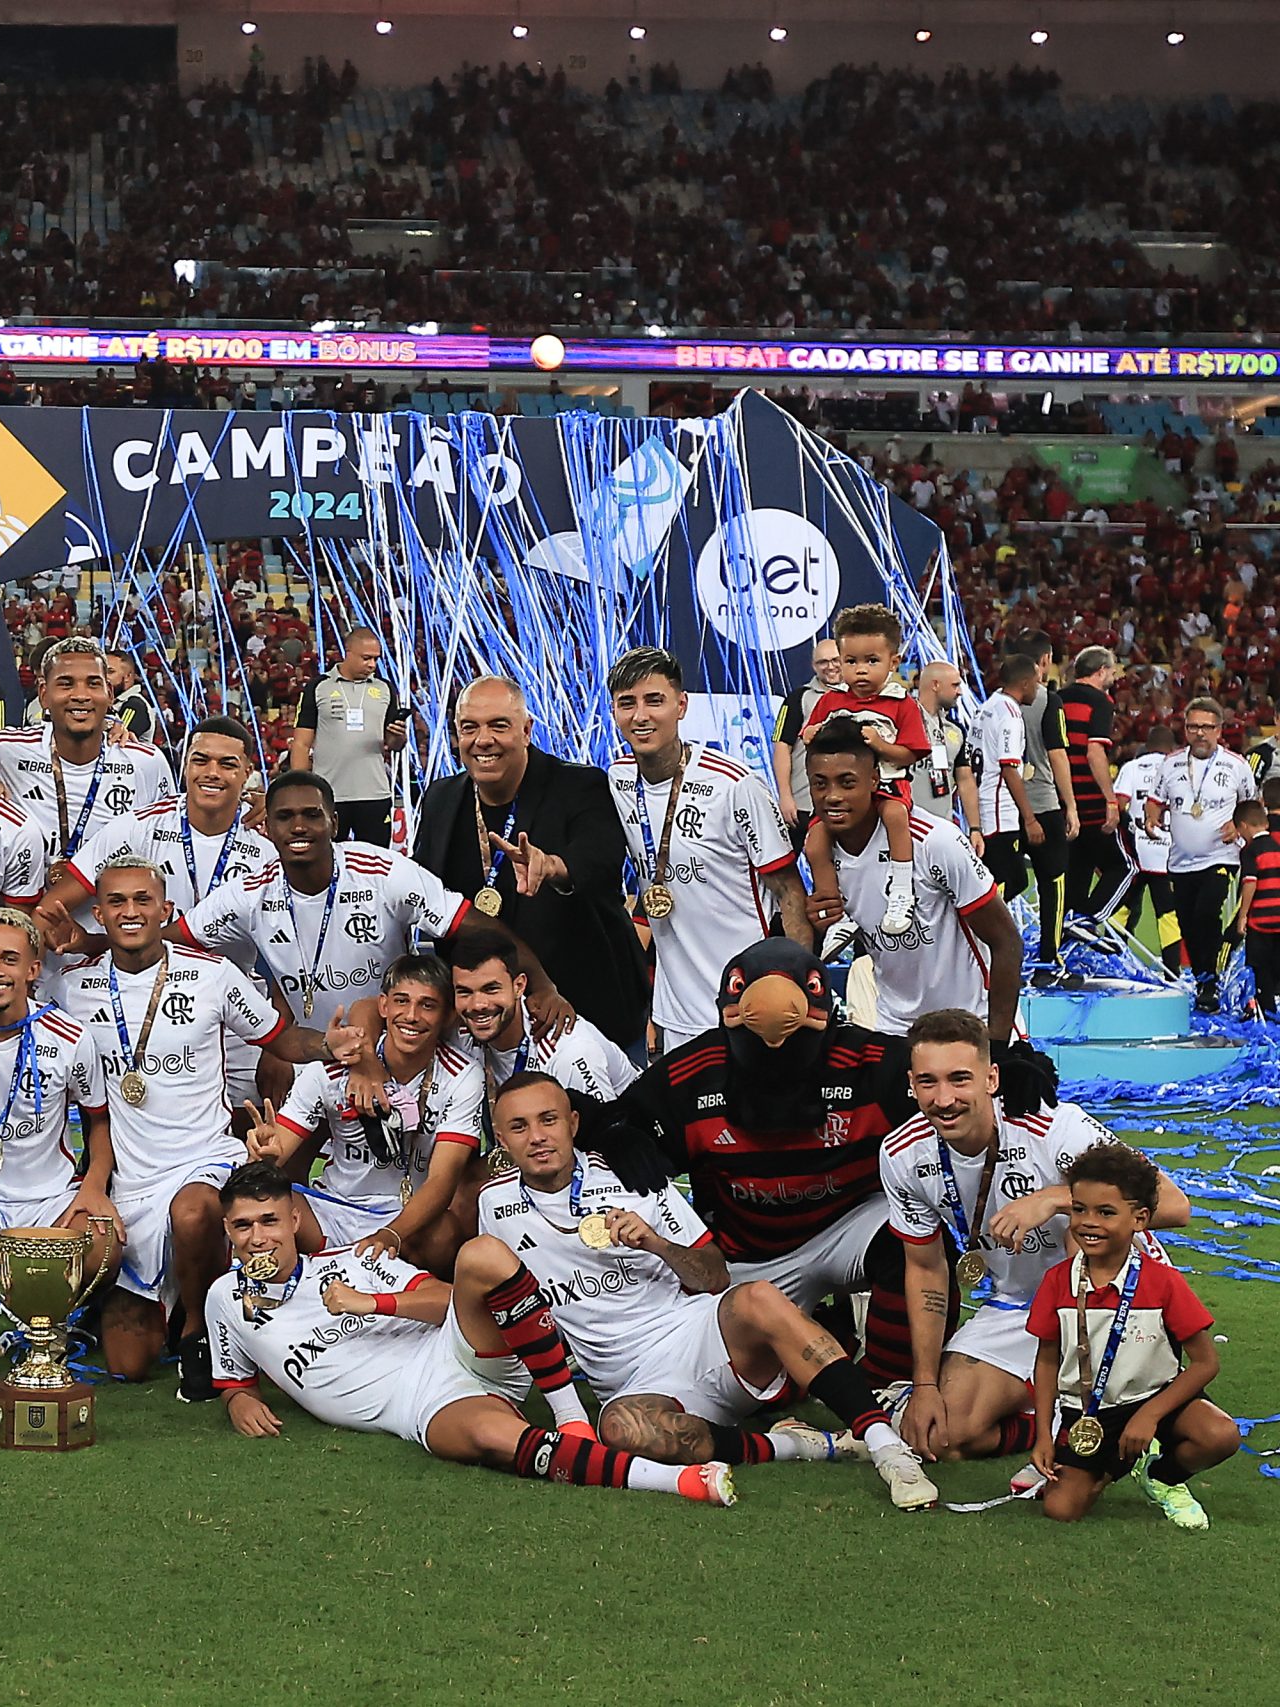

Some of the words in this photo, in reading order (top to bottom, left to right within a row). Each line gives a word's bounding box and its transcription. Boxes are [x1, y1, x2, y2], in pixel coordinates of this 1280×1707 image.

[1, 335, 100, 358] GANHE
[108, 333, 159, 358] ATÉ
[166, 335, 263, 360] R$1700
[269, 339, 311, 360] EM
[318, 335, 417, 361] BÔNUS
[675, 346, 783, 368] BETSAT
[789, 348, 938, 371] CADASTRE
[944, 351, 977, 372] SE
[986, 351, 1003, 372] E
[1011, 351, 1109, 374] GANHE
[1116, 347, 1171, 375] ATÉ
[1177, 351, 1278, 377] R$1700
[113, 427, 522, 508] CAMPEÃO
[270, 490, 362, 520] 2024
[30, 760, 52, 774] BRB
[114, 763, 135, 774] BRB
[693, 782, 714, 797] BRB
[739, 820, 762, 855] kwai
[240, 844, 260, 858] BRB
[351, 889, 373, 903] BRB
[418, 898, 442, 928] kwai
[173, 969, 199, 982] BRB
[281, 959, 382, 996] pixbet
[234, 998, 264, 1029] kwai
[35, 1044, 58, 1059] BRB
[824, 1086, 853, 1100] BRB
[596, 1185, 621, 1196] BRB
[731, 1175, 842, 1206] pixbet
[505, 1203, 529, 1218] BRB
[375, 1264, 399, 1288] kwai
